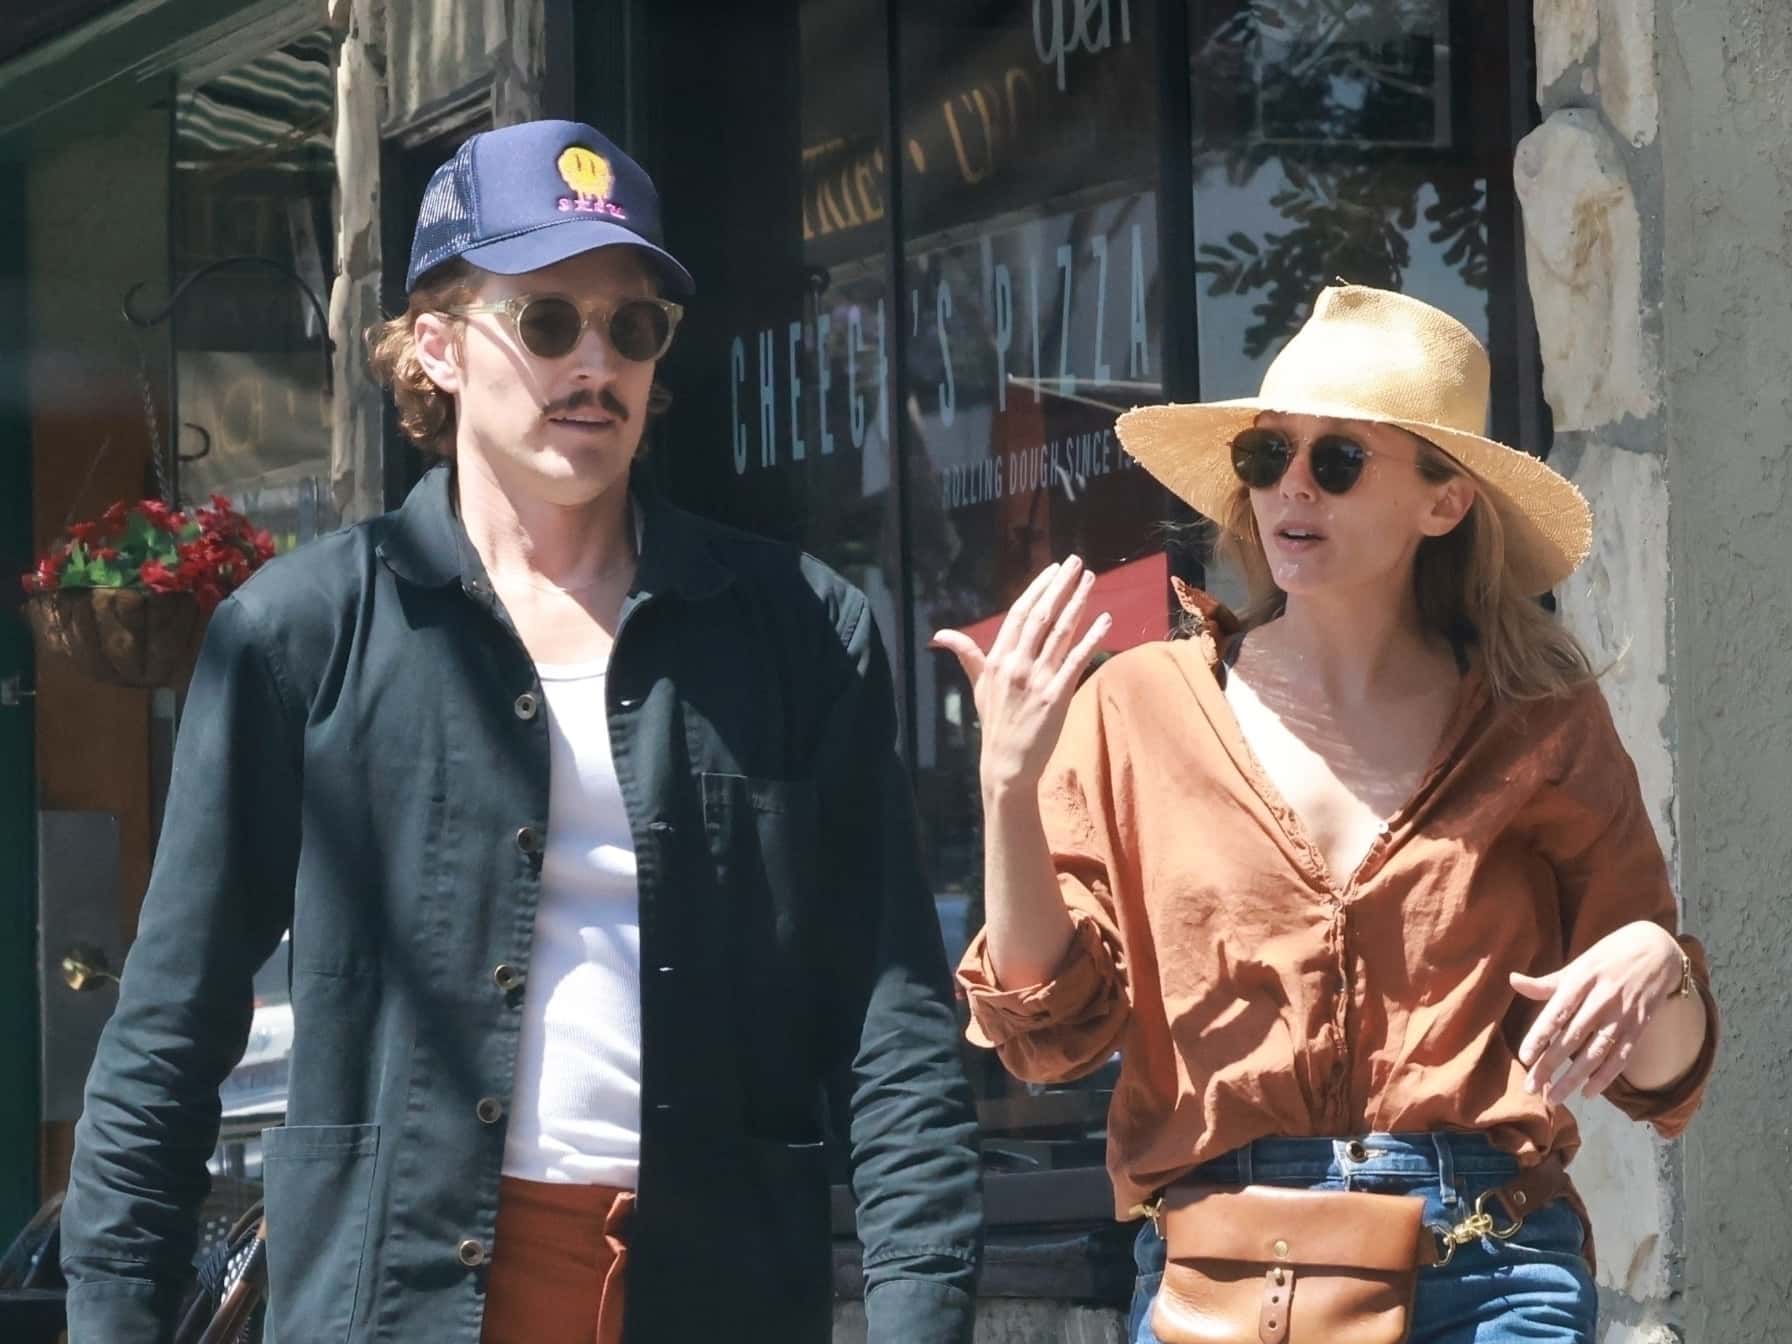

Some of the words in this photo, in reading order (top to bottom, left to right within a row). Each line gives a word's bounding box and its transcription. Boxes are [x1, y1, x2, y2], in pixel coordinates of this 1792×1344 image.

[995, 224, 1149, 413] PIZZA
[943, 455, 1003, 509] ROLLING
[1009, 440, 1060, 496] DOUGH
[1066, 428, 1112, 482] SINCE
